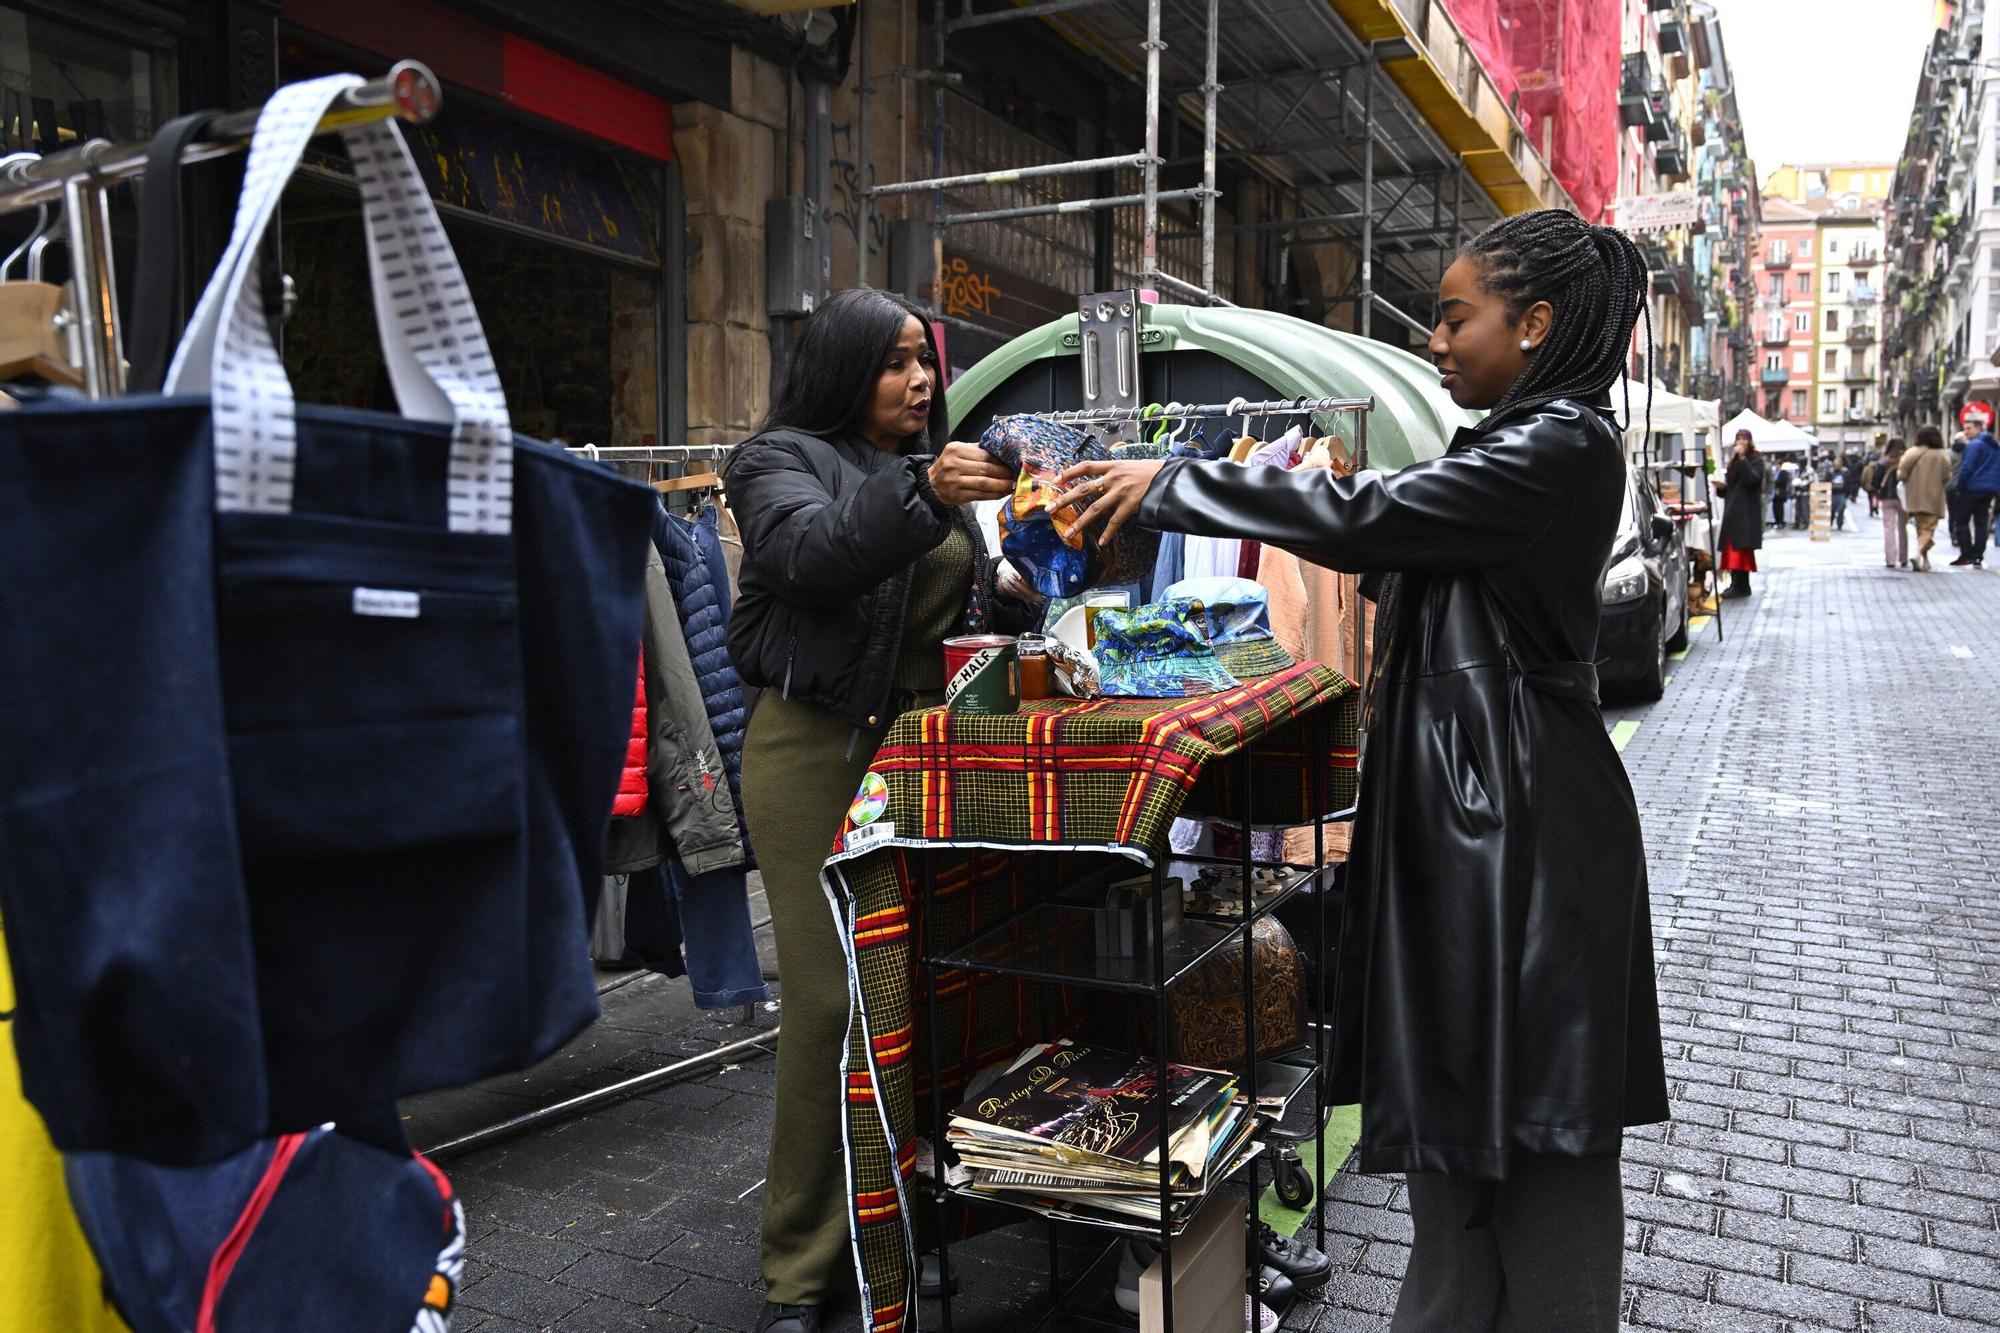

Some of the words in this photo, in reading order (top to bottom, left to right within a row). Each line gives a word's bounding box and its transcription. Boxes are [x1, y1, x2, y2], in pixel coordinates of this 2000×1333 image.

[946, 681, 959, 702] ALF
[961, 650, 990, 681] HALF
[978, 1082, 1035, 1118] Prestige
[1053, 1047, 1091, 1069] Paris
[1171, 1095, 1189, 1106] PAUL
